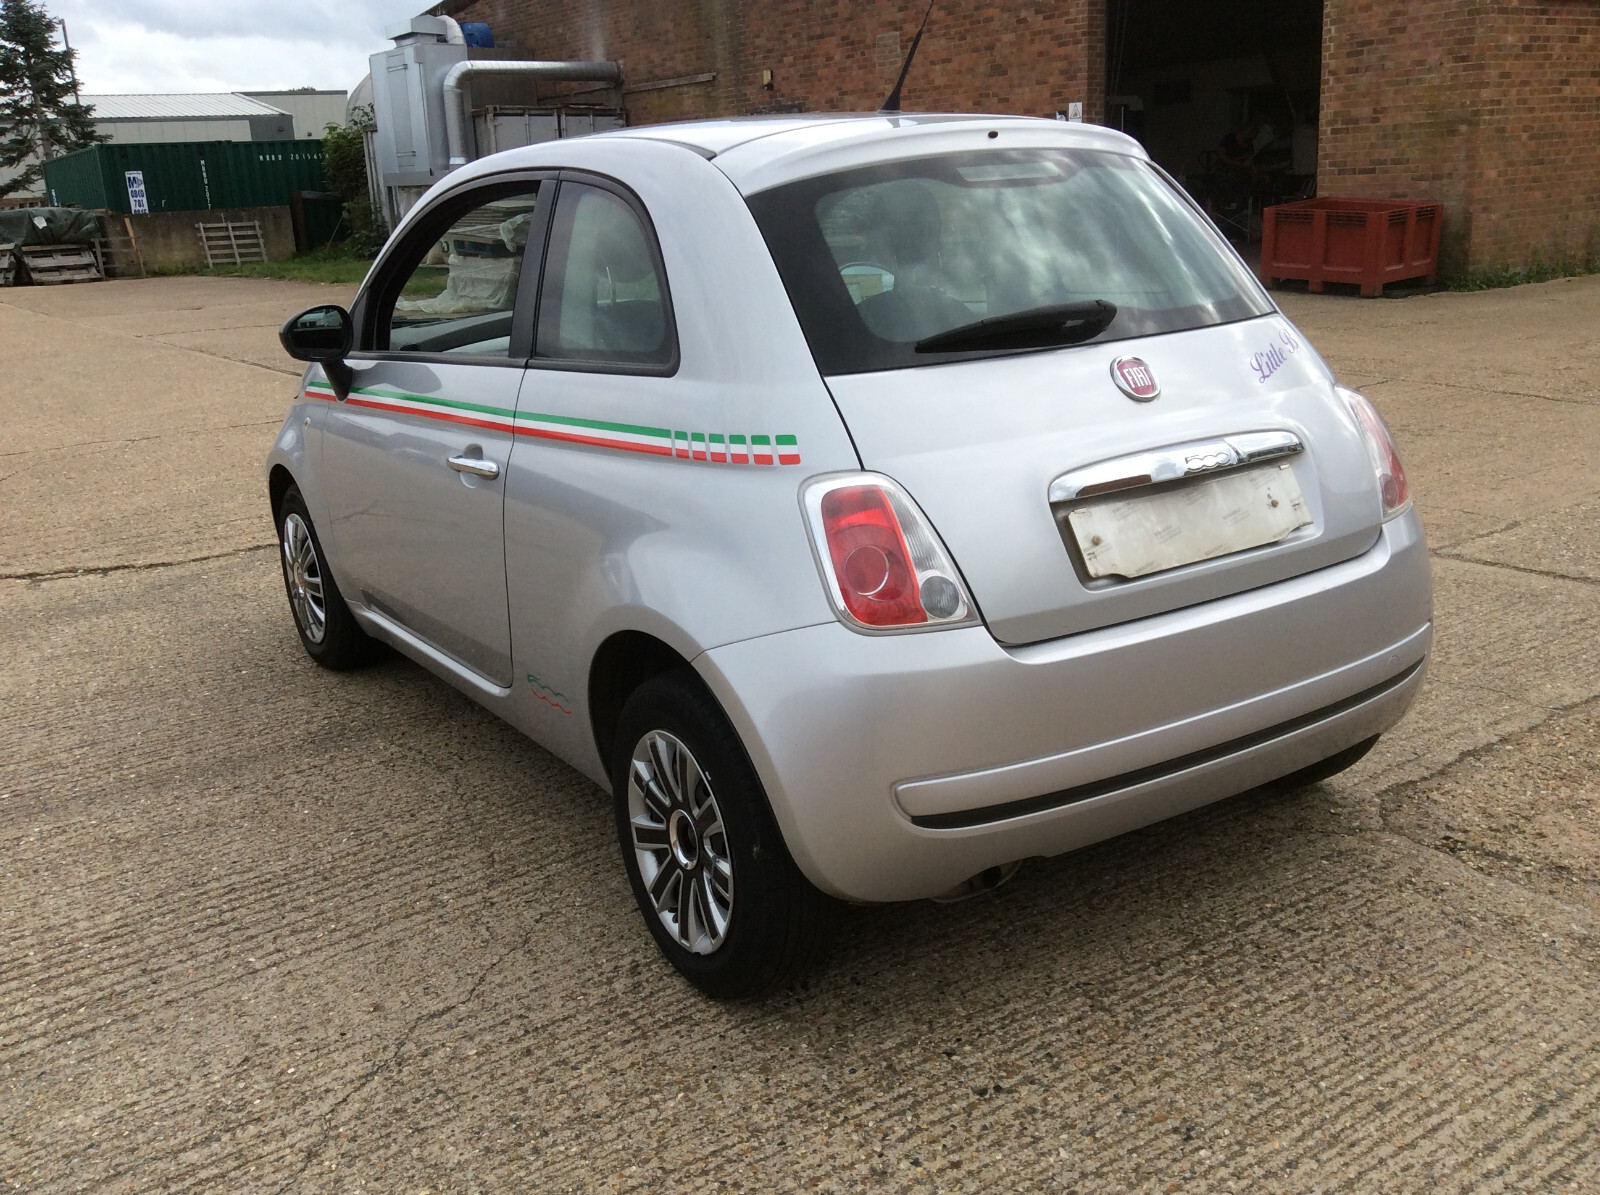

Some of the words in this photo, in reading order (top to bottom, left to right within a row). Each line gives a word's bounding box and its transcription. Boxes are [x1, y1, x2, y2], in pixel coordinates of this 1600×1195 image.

[1249, 342, 1288, 384] Little
[1122, 366, 1152, 389] FIAT
[1184, 452, 1231, 471] 500
